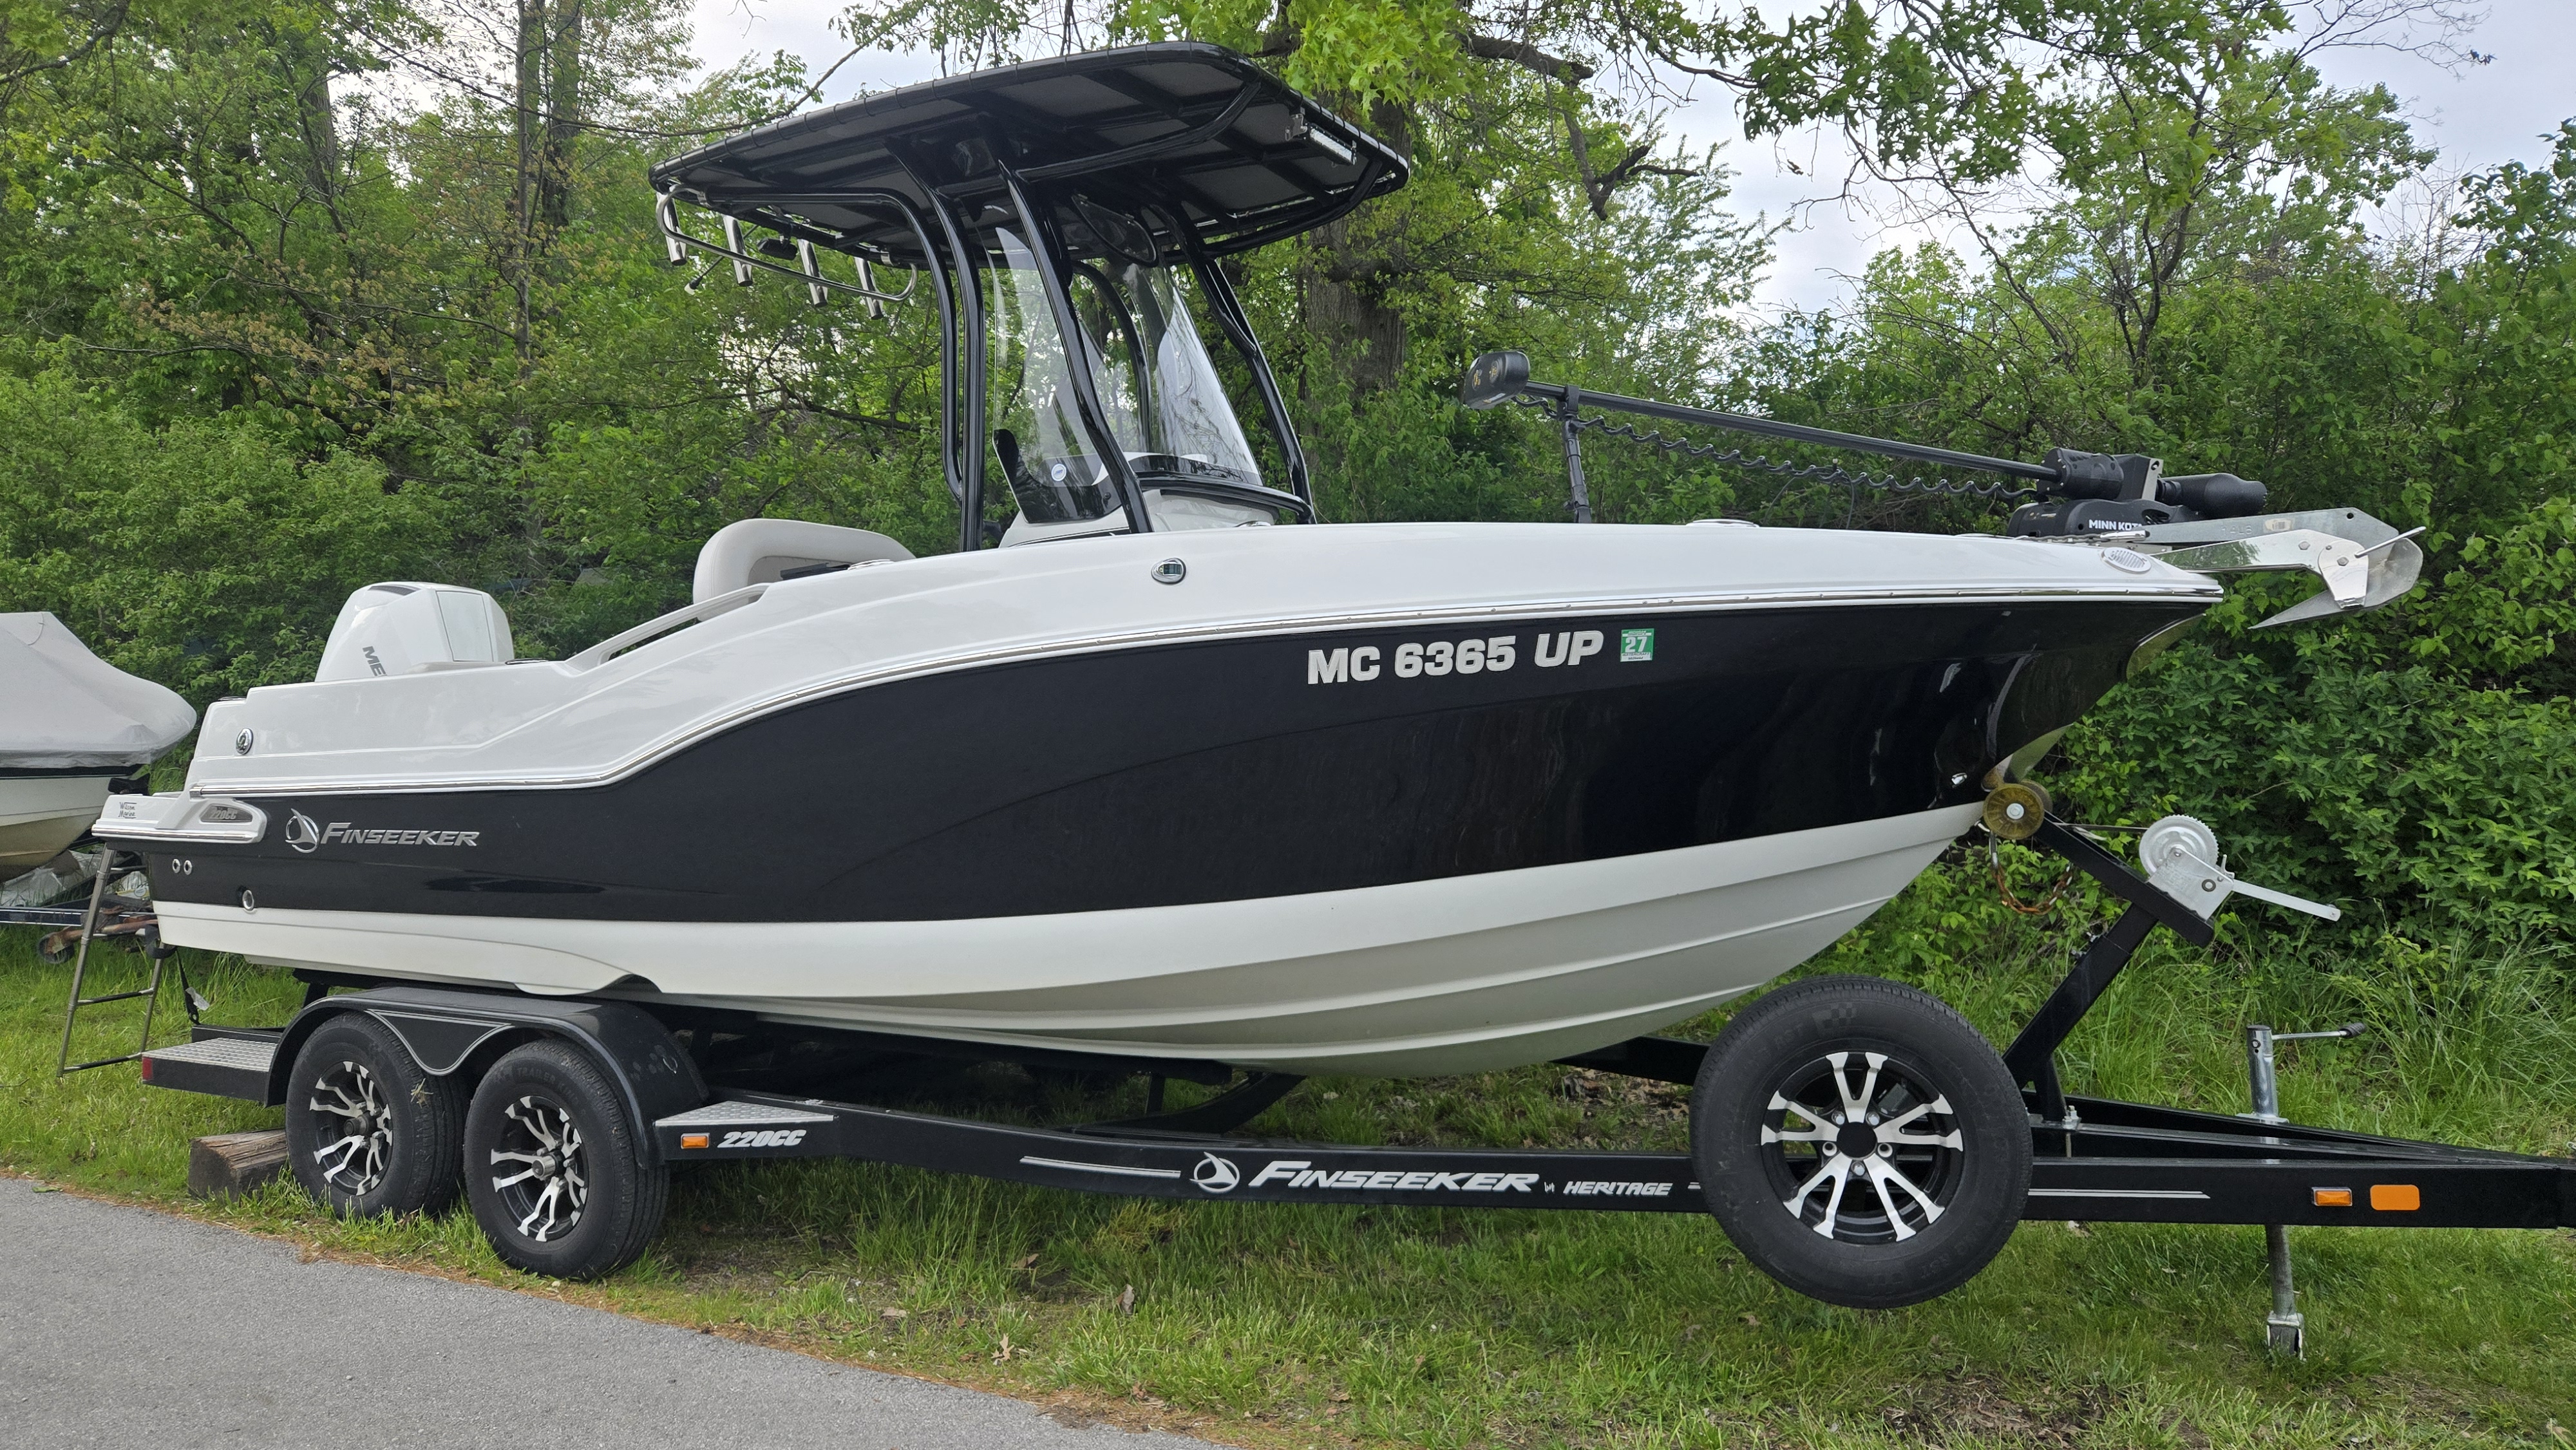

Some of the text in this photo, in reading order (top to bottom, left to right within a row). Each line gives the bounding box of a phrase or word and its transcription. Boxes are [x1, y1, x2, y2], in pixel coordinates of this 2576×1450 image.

[2088, 519, 2117, 530] MINN
[1625, 636, 1647, 653] 27
[1307, 630, 1604, 684] MC 6365 UP
[321, 822, 480, 847] FINSEEKER
[717, 1129, 807, 1148] 220CC
[1248, 1160, 1540, 1192] FINSEEKER
[1562, 1180, 1674, 1196] HERITAGE
